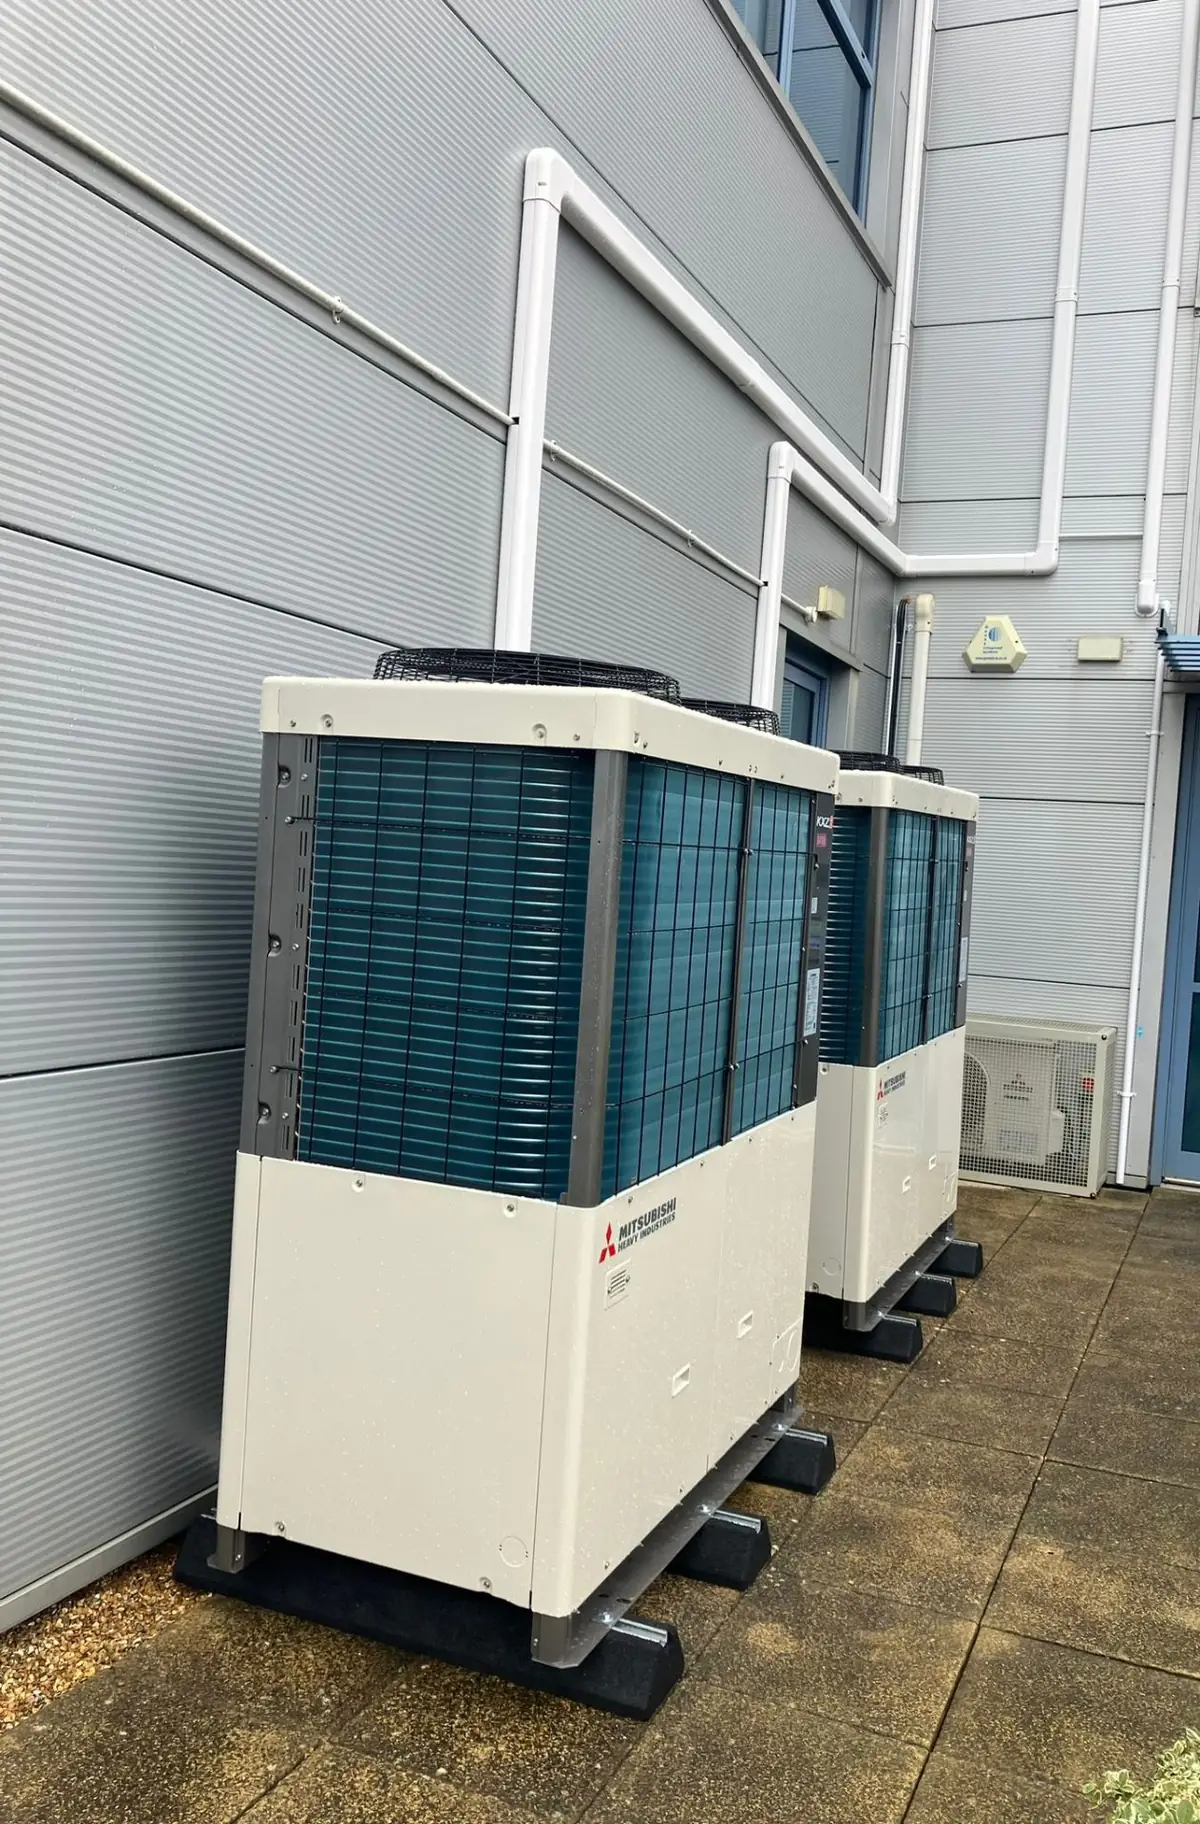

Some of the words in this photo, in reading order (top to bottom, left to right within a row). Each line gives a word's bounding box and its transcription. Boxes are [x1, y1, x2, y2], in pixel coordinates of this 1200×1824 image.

[617, 1233, 639, 1253] HEAVY
[639, 1212, 676, 1240] INDUSTRIES
[619, 1197, 676, 1242] MITSUBISHI
